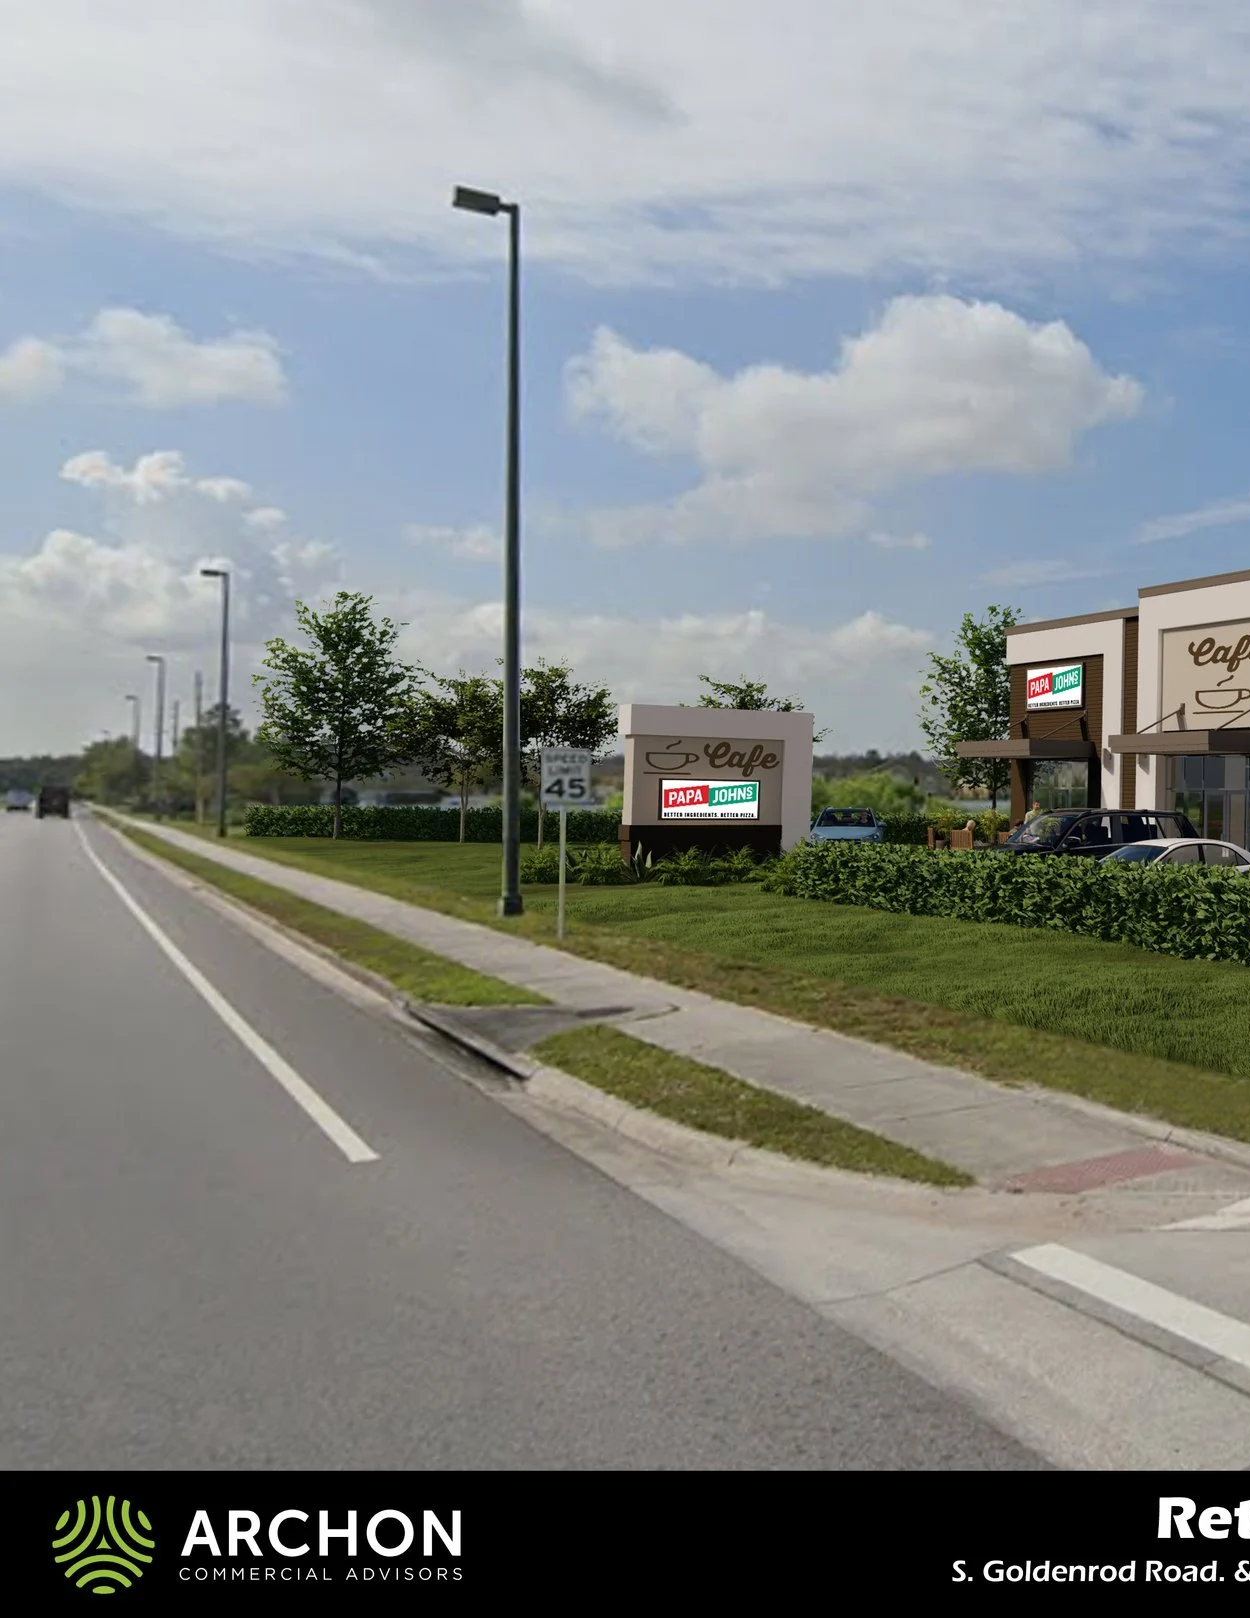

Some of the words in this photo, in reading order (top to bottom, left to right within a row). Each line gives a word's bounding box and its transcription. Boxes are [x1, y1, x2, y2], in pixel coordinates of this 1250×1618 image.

[1030, 677, 1050, 696] PAPA
[545, 754, 588, 764] SPEED
[704, 741, 780, 777] Cafe
[548, 765, 582, 777] LIMIT
[545, 778, 586, 799] 45
[668, 788, 703, 805] PAPA
[713, 786, 753, 804] JOHNS
